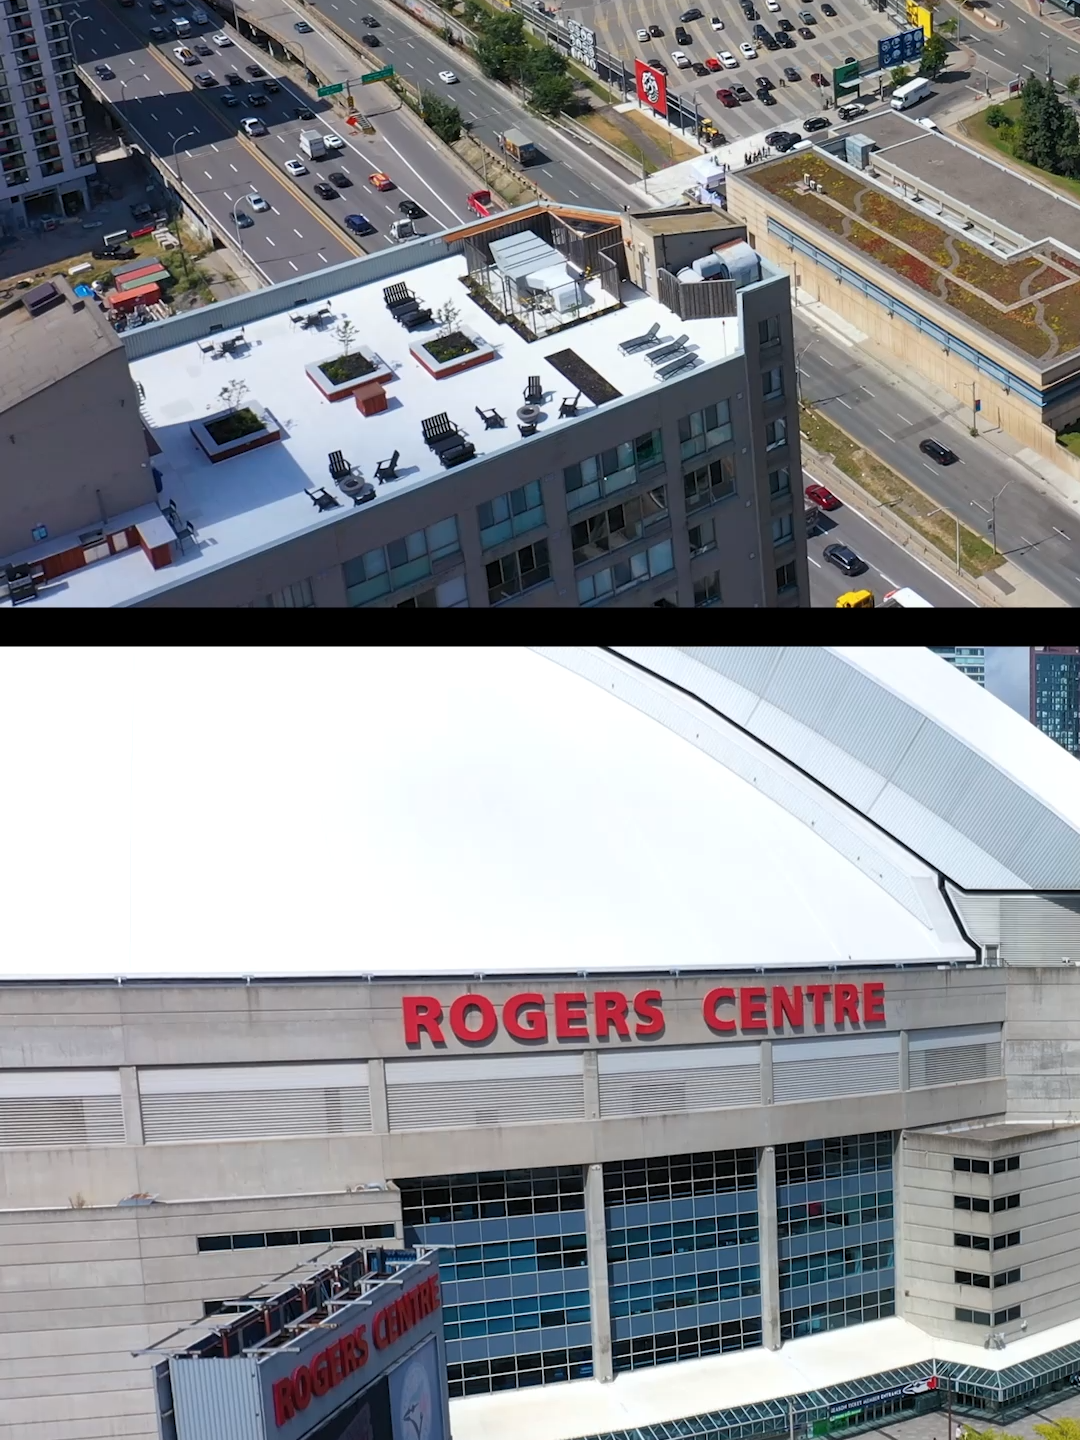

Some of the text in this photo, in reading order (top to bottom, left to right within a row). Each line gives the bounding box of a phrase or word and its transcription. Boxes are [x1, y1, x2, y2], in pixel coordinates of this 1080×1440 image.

[402, 982, 886, 1044] ROGERS CENTRE
[271, 1273, 441, 1428] ROGERS CENTRE
[848, 1400, 862, 1409] TICKET
[880, 1389, 902, 1400] ENTRANCE
